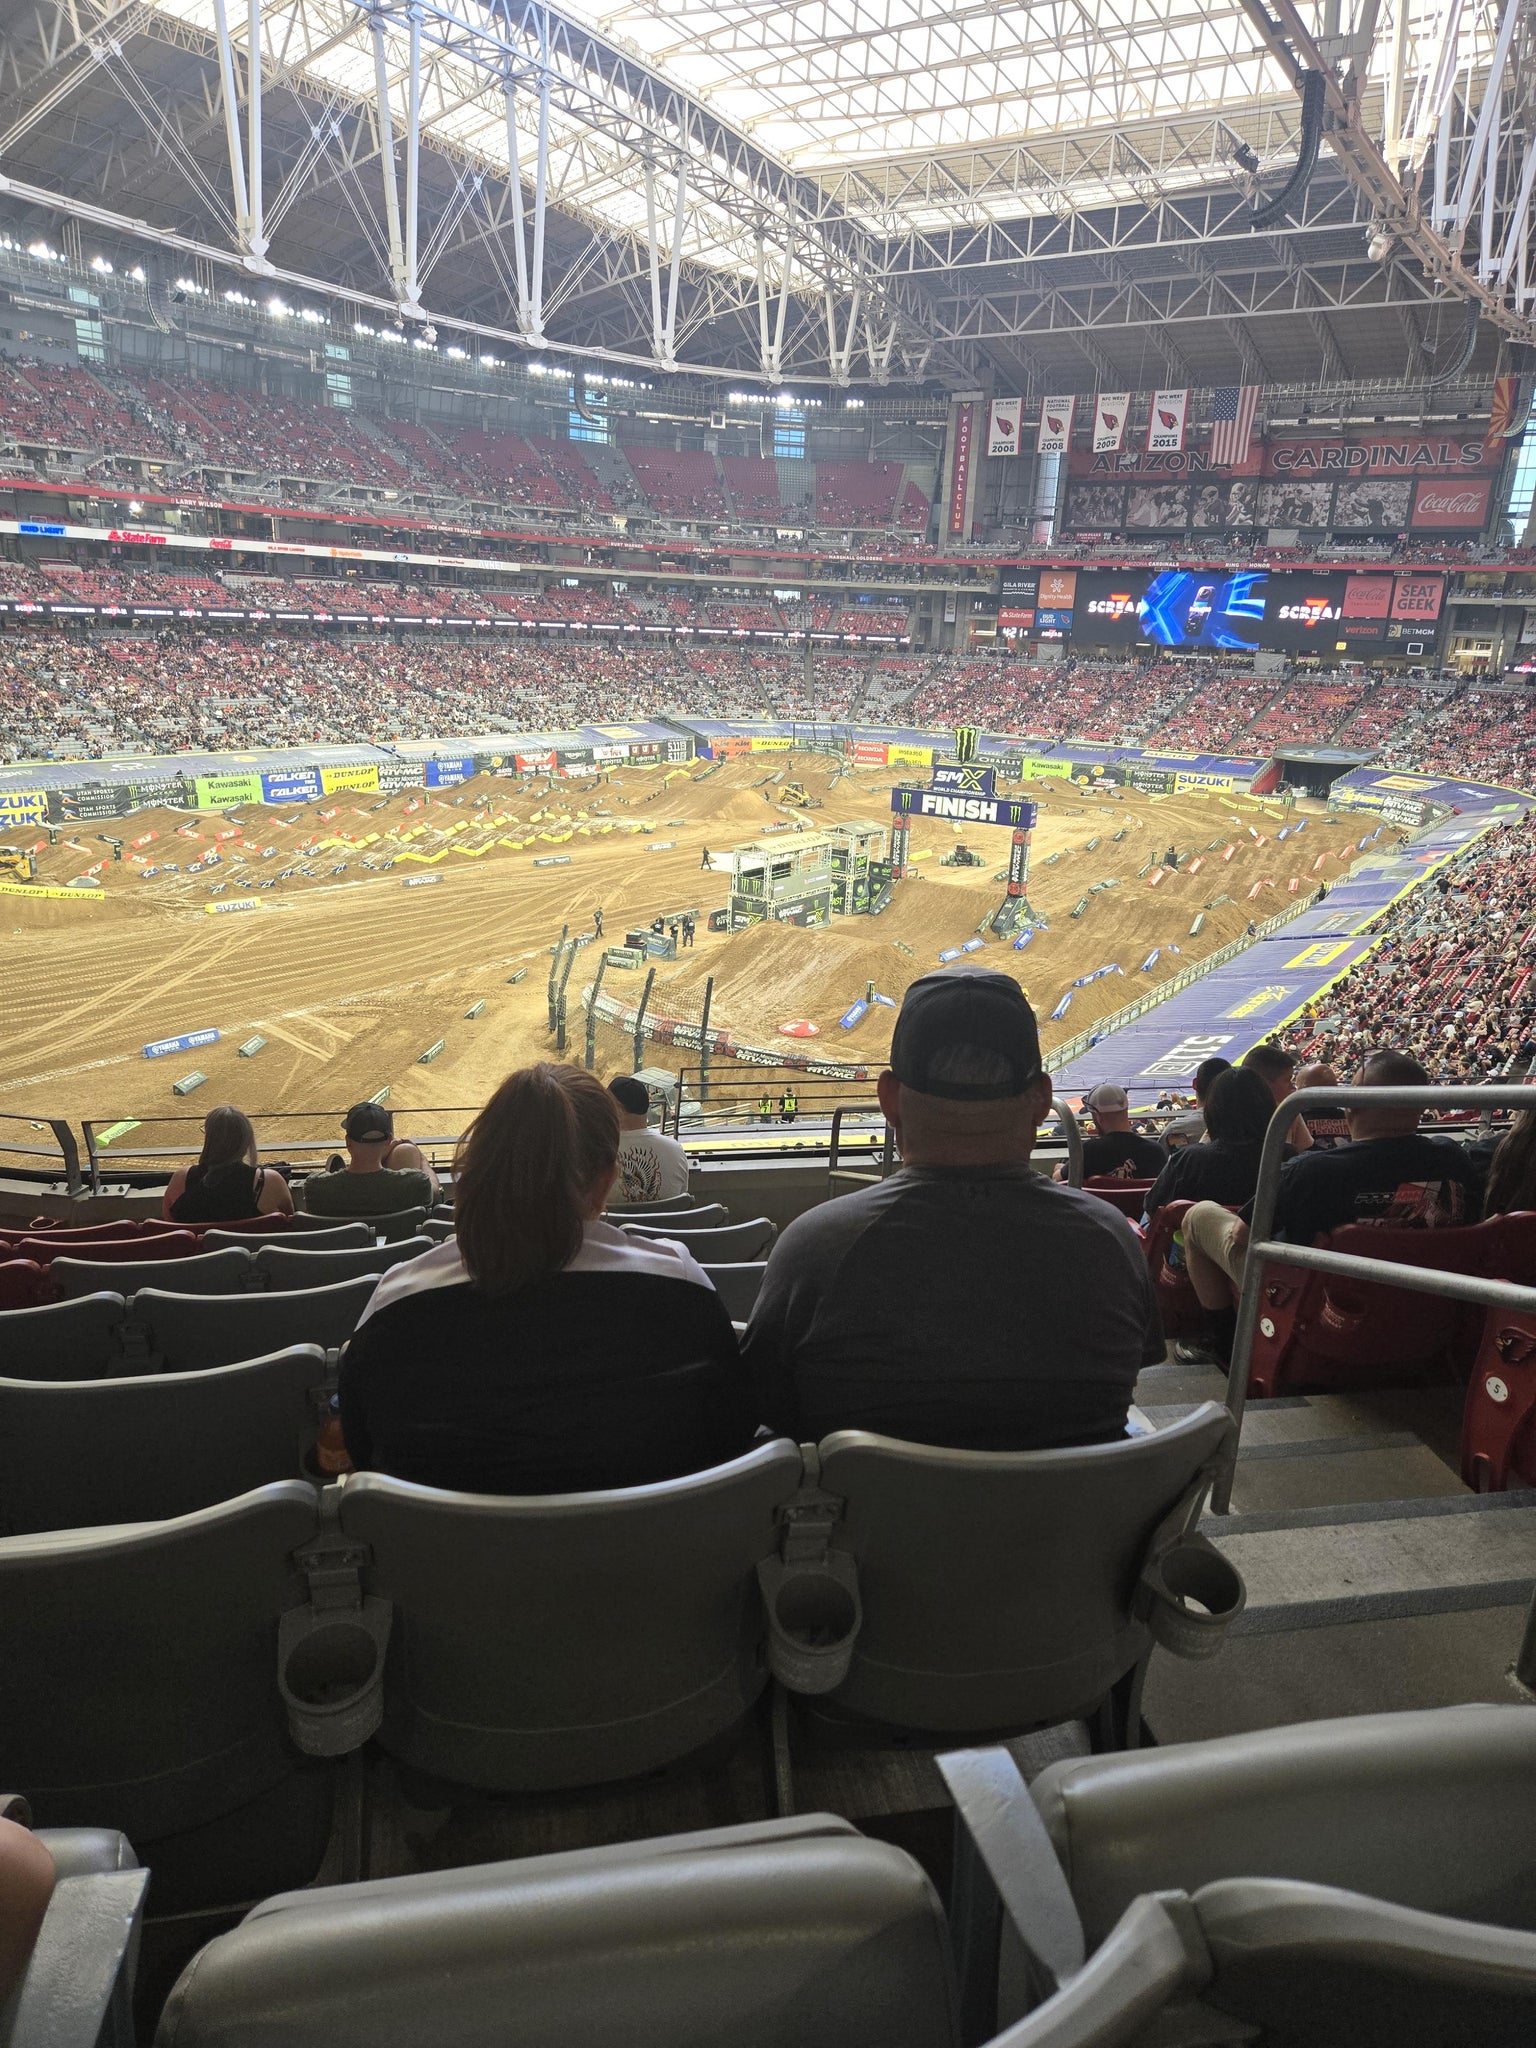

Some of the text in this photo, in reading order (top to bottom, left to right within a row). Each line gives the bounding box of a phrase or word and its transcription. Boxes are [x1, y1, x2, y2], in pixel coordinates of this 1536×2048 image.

[1041, 442, 1064, 450] 2008
[1096, 440, 1117, 450] 2009
[1152, 439, 1178, 447] 2015
[991, 445, 1015, 453] 2008
[1272, 442, 1484, 470] CARDINALS
[198, 500, 223, 509] WILSON
[1401, 584, 1437, 598] SEAT
[1040, 594, 1056, 602] Dignity
[1396, 598, 1436, 612] GEEK
[1344, 626, 1379, 635] verizon
[1401, 627, 1435, 636] BETMGM
[857, 745, 885, 753] HONDA
[989, 758, 1021, 766] OAKLEY
[1031, 761, 1064, 771] Kawasaki
[268, 771, 316, 783] FALKEN
[332, 767, 375, 779] DUNLOP
[1134, 771, 1166, 779] MONSTER
[207, 778, 252, 790] Kawasaki
[934, 768, 987, 791] SMX
[1178, 774, 1231, 787] SUZUKI
[140, 781, 184, 793] MONSTER
[270, 785, 318, 797] FALKEN
[950, 787, 986, 796] CHAMPIONSHIP
[77, 794, 115, 802] COMMISSION
[210, 793, 253, 804] Kawasaki
[921, 794, 998, 822] FINISH
[79, 809, 118, 818] COMMISSION
[138, 834, 152, 845] FLY
[221, 830, 235, 839] FLY
[1, 887, 44, 895] DUNLOP
[215, 901, 256, 912] SUZUKI
[158, 1041, 180, 1051] YAMAHA
[1493, 1384, 1501, 1394] 5
